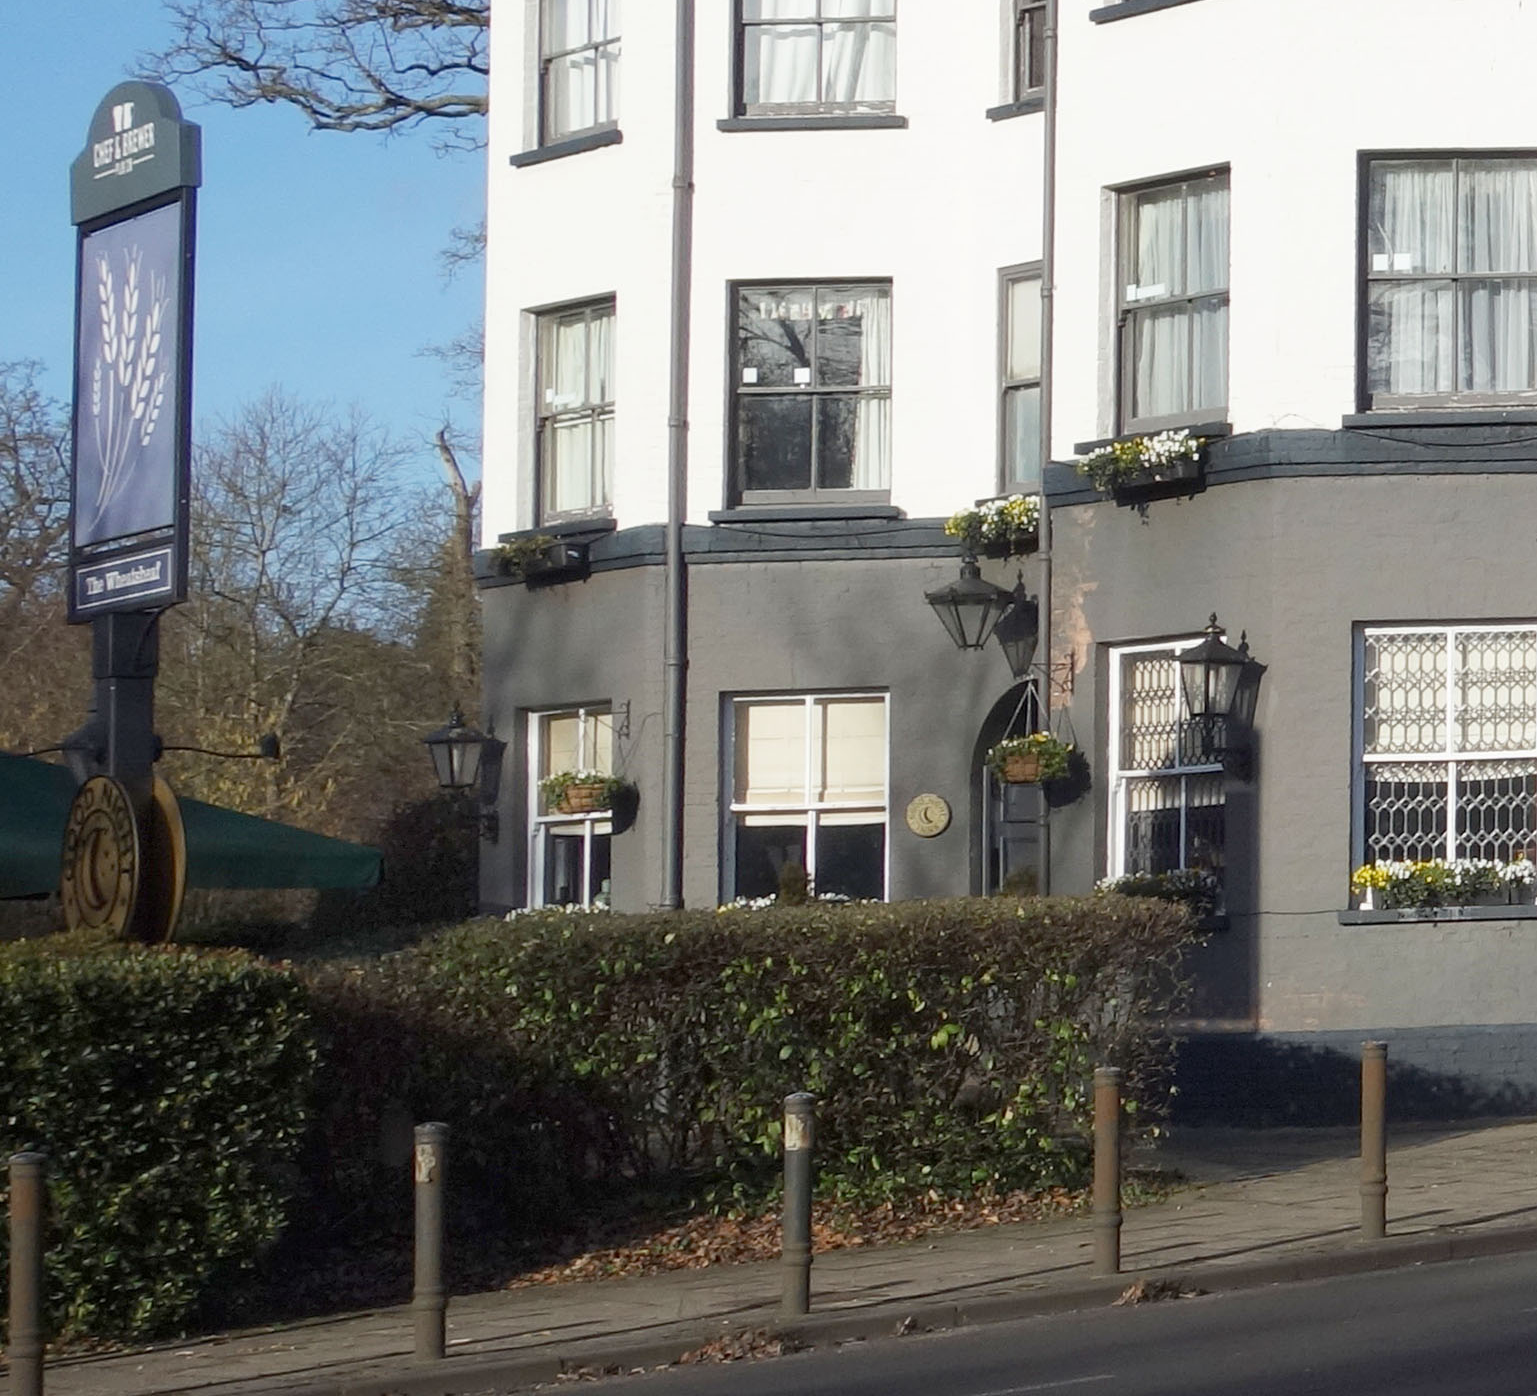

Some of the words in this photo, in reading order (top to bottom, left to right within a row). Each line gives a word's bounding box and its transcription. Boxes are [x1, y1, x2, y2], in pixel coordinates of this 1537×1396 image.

[93, 138, 114, 168] CHEF
[114, 135, 122, 160] &
[122, 122, 155, 157] BREWER
[84, 576, 104, 595] The
[105, 560, 162, 591] Wheatsheaf
